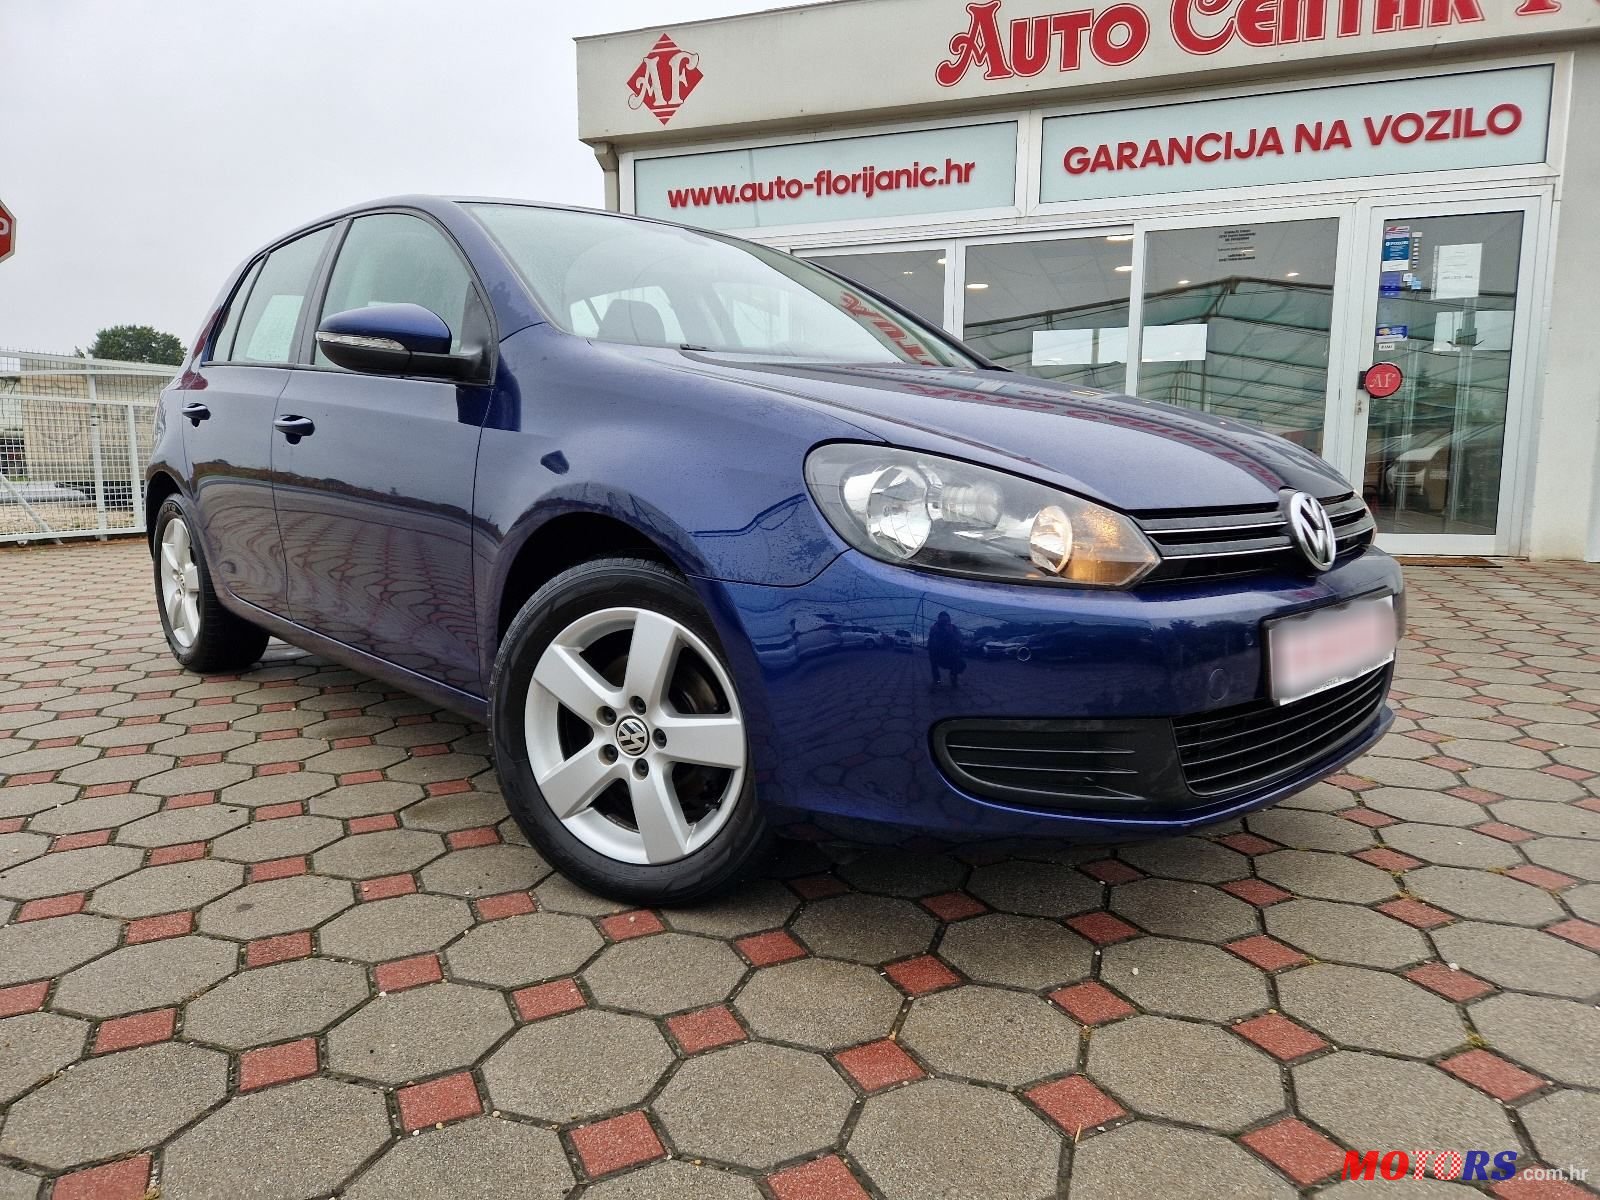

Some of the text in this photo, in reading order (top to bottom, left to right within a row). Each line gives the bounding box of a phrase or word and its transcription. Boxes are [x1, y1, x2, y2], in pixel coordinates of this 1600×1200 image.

[935, 0, 1150, 87] AUTO
[628, 51, 699, 110] AF
[1063, 102, 1523, 175] GARANCIJA NA VOZILO
[667, 158, 976, 208] www.auto-florijanic.hr
